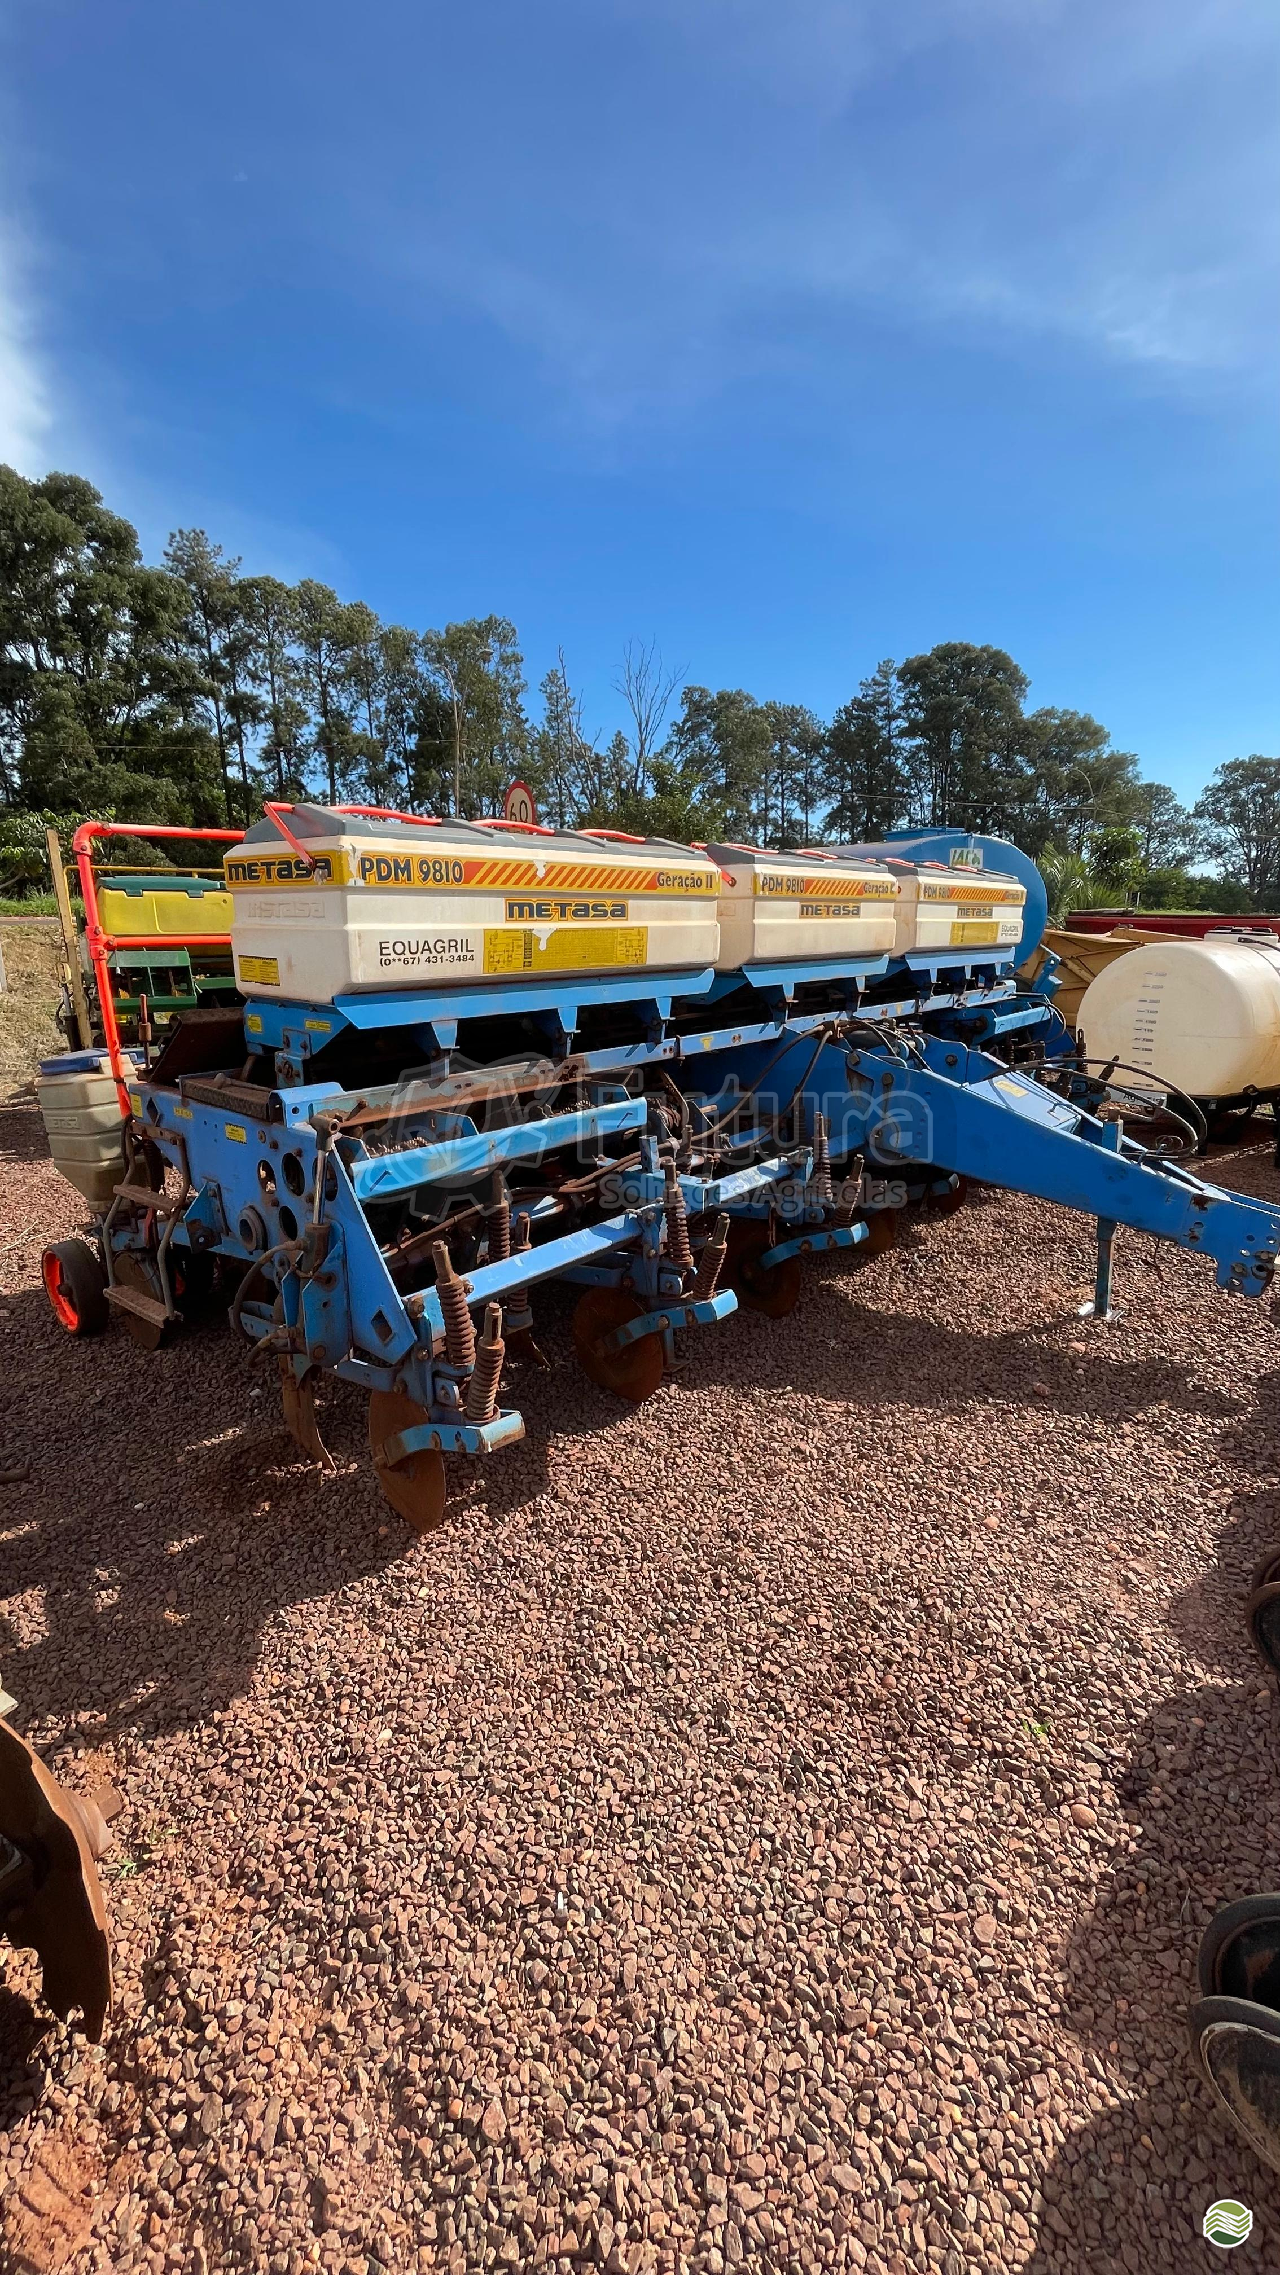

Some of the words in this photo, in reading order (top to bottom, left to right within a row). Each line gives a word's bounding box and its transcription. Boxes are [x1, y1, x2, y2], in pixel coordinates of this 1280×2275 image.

[228, 858, 332, 882] METASA
[360, 857, 414, 882] PDM
[418, 860, 464, 884] 9810
[656, 872, 703, 892] Geração
[762, 877, 783, 892] PDM
[786, 878, 805, 893] 9810
[863, 881, 889, 898] Geração
[508, 902, 627, 919] METASA
[801, 904, 860, 916] METASA
[957, 907, 993, 917] METASA
[379, 939, 475, 957] EQUAGRIL
